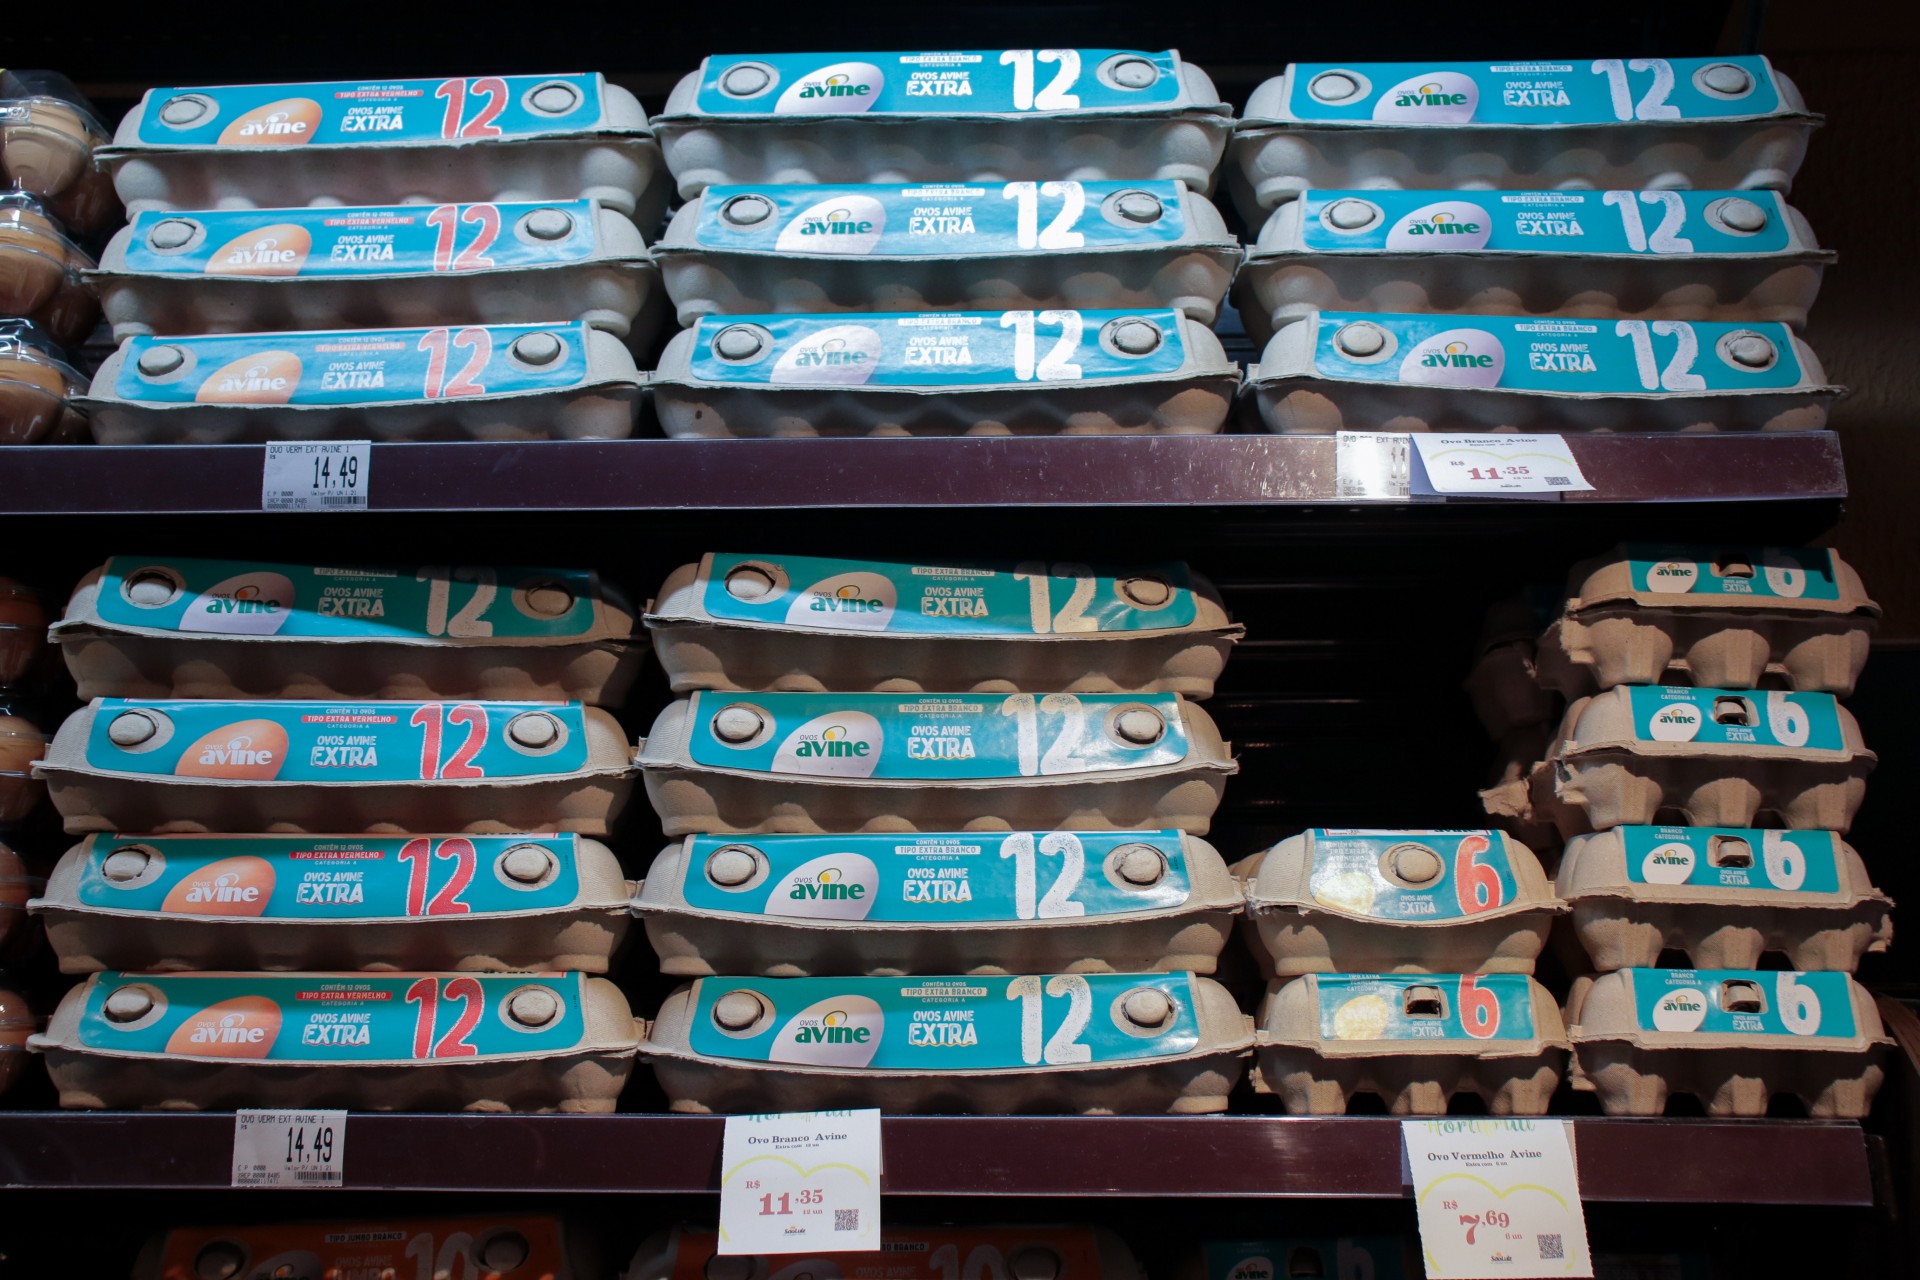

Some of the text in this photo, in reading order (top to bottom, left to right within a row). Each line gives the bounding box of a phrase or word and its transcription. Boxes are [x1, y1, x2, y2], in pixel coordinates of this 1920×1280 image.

[912, 72, 970, 80] OVOS AVINE
[1000, 49, 1081, 110] 12
[1506, 81, 1564, 89] OVOS AVINE
[800, 80, 870, 98] avine
[907, 80, 972, 96] EXTRA
[1591, 58, 1681, 121] 12
[1395, 90, 1467, 106] avine
[1504, 90, 1571, 106] EXTRA
[348, 106, 403, 115] OVOS AVINE
[435, 78, 509, 138] 12
[240, 117, 306, 136] avine
[340, 116, 403, 132] EXTRA
[1002, 181, 1084, 249] 12
[1518, 212, 1576, 220] OVOS AVINE
[1602, 190, 1694, 253] 12
[800, 216, 872, 235] avine
[909, 217, 976, 234] EXTRA
[1408, 220, 1480, 235] avine
[1516, 220, 1584, 235] EXTRA
[426, 204, 500, 271] 12
[228, 244, 296, 264] avine
[331, 244, 394, 262] EXTRA
[1000, 310, 1082, 380] 12
[1531, 343, 1590, 352] OVOS AVINE
[418, 328, 492, 398] 12
[796, 347, 868, 366] avine
[904, 346, 972, 365] EXTRA
[1421, 350, 1494, 368] avine
[1530, 353, 1597, 372] EXTRA
[1616, 320, 1706, 390] 12
[218, 372, 286, 392] avine
[321, 371, 384, 389] EXTRA
[313, 456, 358, 488] 14,49
[1467, 466, 1530, 479] 11,35
[1656, 566, 1692, 577] avine
[1764, 547, 1806, 598] 6
[416, 566, 497, 638] 12
[925, 588, 984, 597] OVOS AVINE
[1014, 560, 1098, 634] 12
[206, 596, 280, 614] avine
[318, 598, 384, 616] EXTRA
[810, 595, 883, 613] avine
[922, 597, 988, 616] EXTRA
[1660, 714, 1695, 723] avine
[1767, 691, 1810, 747] 6
[317, 736, 376, 745] OVOS AVINE
[912, 726, 971, 736] OVOS AVINE
[1002, 694, 1086, 776] 12
[1726, 732, 1756, 742] EXTRA
[410, 704, 488, 780] 12
[796, 739, 870, 758] avine
[908, 737, 976, 759] EXTRA
[199, 746, 272, 765] avine
[310, 746, 378, 766] EXTRA
[900, 846, 976, 854] TIPO EXTRA BRANCO
[1763, 829, 1806, 890] 6
[1652, 855, 1688, 866] avine
[304, 872, 364, 882] OVOS AVINE
[398, 838, 477, 916] 12
[907, 868, 968, 878] OVOS AVINE
[1000, 833, 1084, 919] 12
[1455, 835, 1503, 915] 6
[1720, 874, 1750, 885] EXTRA
[186, 883, 258, 902] avine
[296, 883, 364, 903] EXTRA
[790, 881, 865, 900] avine
[903, 880, 972, 901] EXTRA
[1399, 902, 1436, 914] EXTRA
[906, 988, 982, 996] TIPO EXTRA BRANCO
[1459, 974, 1499, 1039] 6
[1664, 1001, 1700, 1011] avine
[1776, 971, 1822, 1035] 6
[310, 1013, 371, 1023] OVOS AVINE
[405, 978, 483, 1058] 12
[913, 1010, 974, 1021] OVOS AVINE
[1006, 976, 1092, 1064] 12
[190, 1024, 264, 1044] avine
[302, 1024, 370, 1044] EXTRA
[795, 1025, 870, 1044] avine
[909, 1022, 977, 1045] EXTRA
[1411, 1027, 1445, 1037] EXTRA
[1733, 1020, 1765, 1031] EXTRA
[279, 1115, 292, 1123] EXT
[295, 1115, 316, 1123] AVINE
[286, 1127, 333, 1162] 14,49
[1427, 1149, 1542, 1160] Ovo Vermelho Avine
[746, 1180, 760, 1189] R$
[759, 1189, 823, 1215] 11,35
[1443, 1200, 1458, 1210] R$
[329, 1232, 402, 1242] TIPO JUMBO BRANCO
[1459, 1210, 1510, 1245] 7,69
